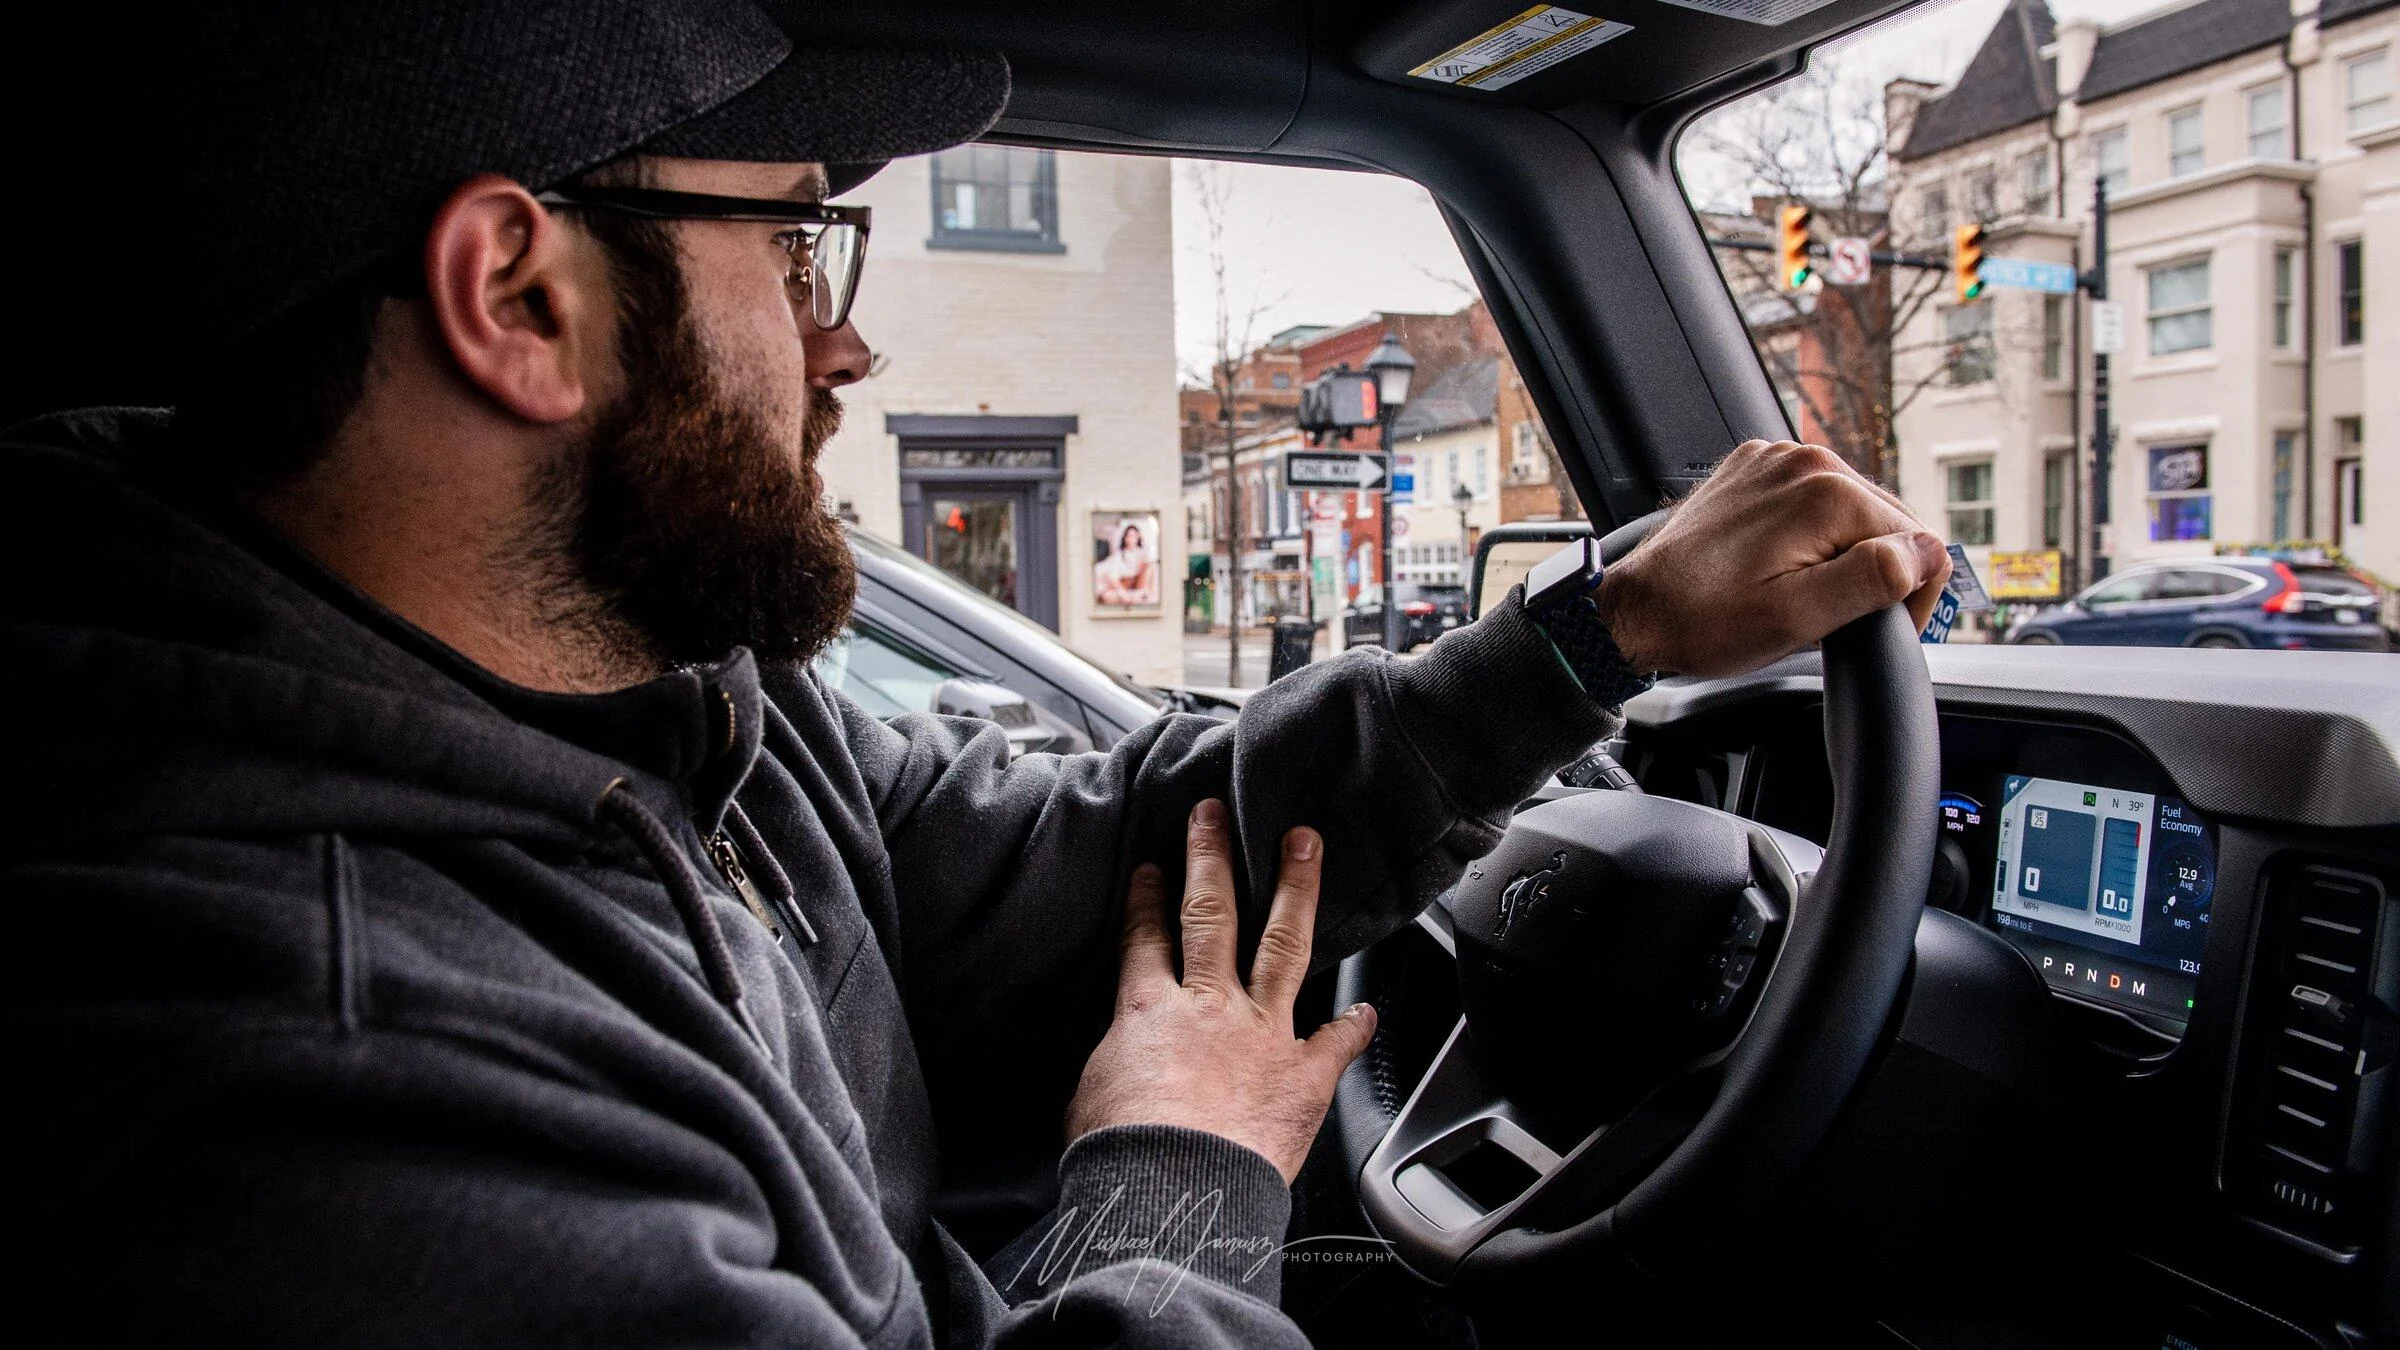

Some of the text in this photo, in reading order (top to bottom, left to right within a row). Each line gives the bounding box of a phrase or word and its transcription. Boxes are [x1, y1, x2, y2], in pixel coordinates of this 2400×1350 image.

[2112, 798, 2119, 808] N
[1945, 807, 1980, 824] 100 120
[2162, 805, 2182, 818] Fuel
[1946, 821, 1963, 831] MPH
[2034, 816, 2044, 827] 25
[2160, 818, 2203, 836] Economy
[2024, 867, 2040, 892] 0
[2178, 867, 2198, 881] 12.9
[2179, 880, 2194, 891] Avg
[2023, 901, 2039, 912] MPH
[2102, 889, 2128, 913] 0.0
[2162, 906, 2168, 914] 0
[2174, 918, 2191, 929] MPG
[2199, 913, 2209, 923] 40
[2043, 957, 2146, 996] P R N D M
